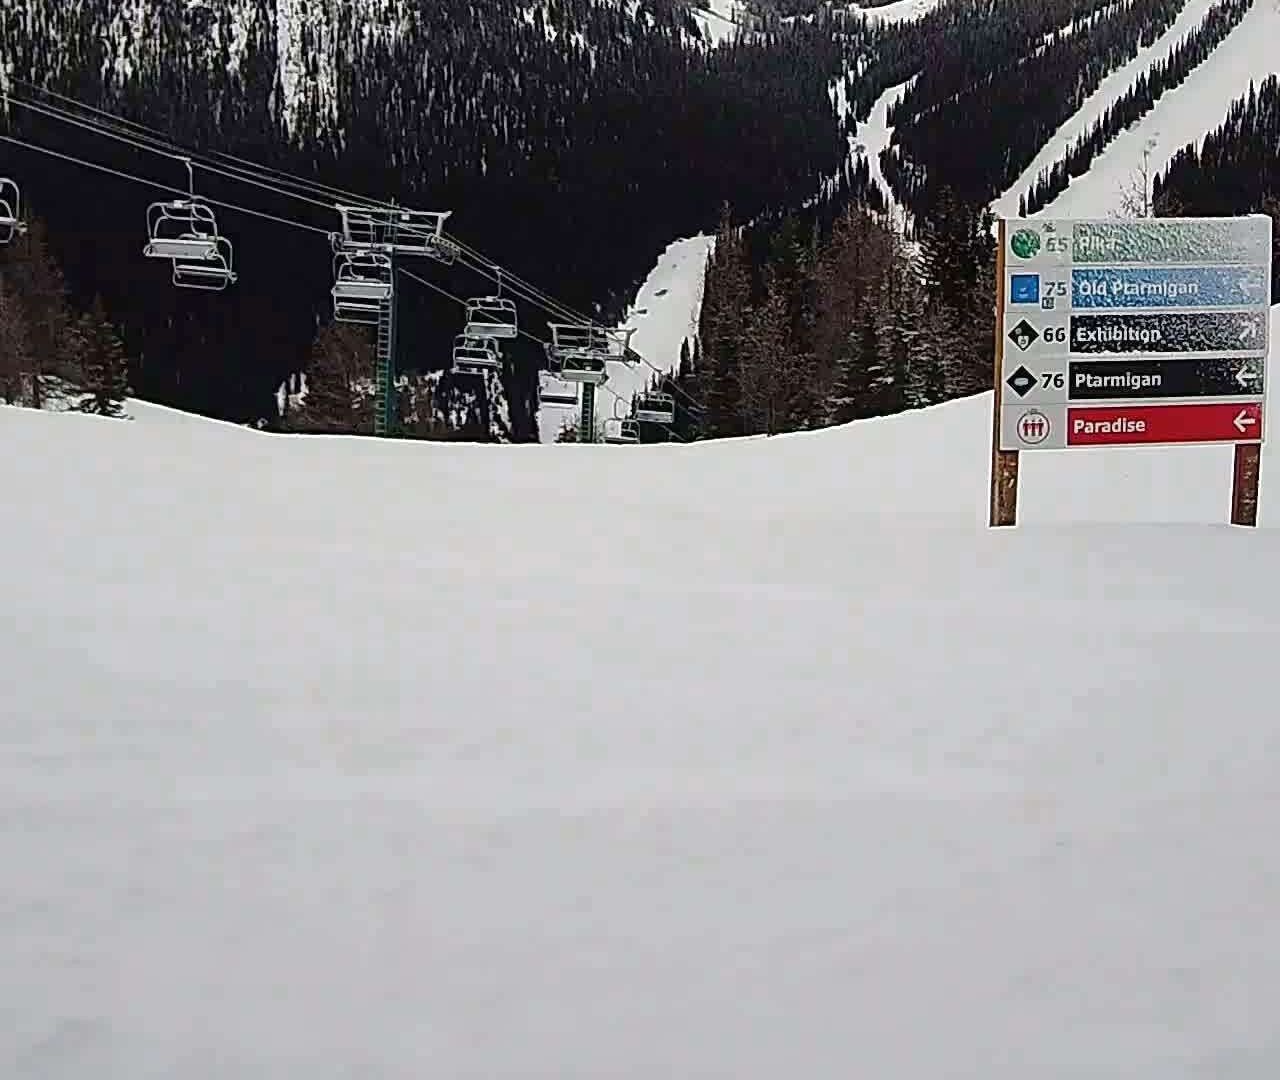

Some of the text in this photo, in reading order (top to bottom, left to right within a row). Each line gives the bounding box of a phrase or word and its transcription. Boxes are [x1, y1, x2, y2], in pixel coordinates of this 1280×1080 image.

[1045, 281, 1198, 300] 75 Old Ptarmigan
[1043, 326, 1161, 343] 66 Exhibition
[1041, 373, 1161, 390] 76 Ptarmigan
[1073, 418, 1146, 433] Paradise
